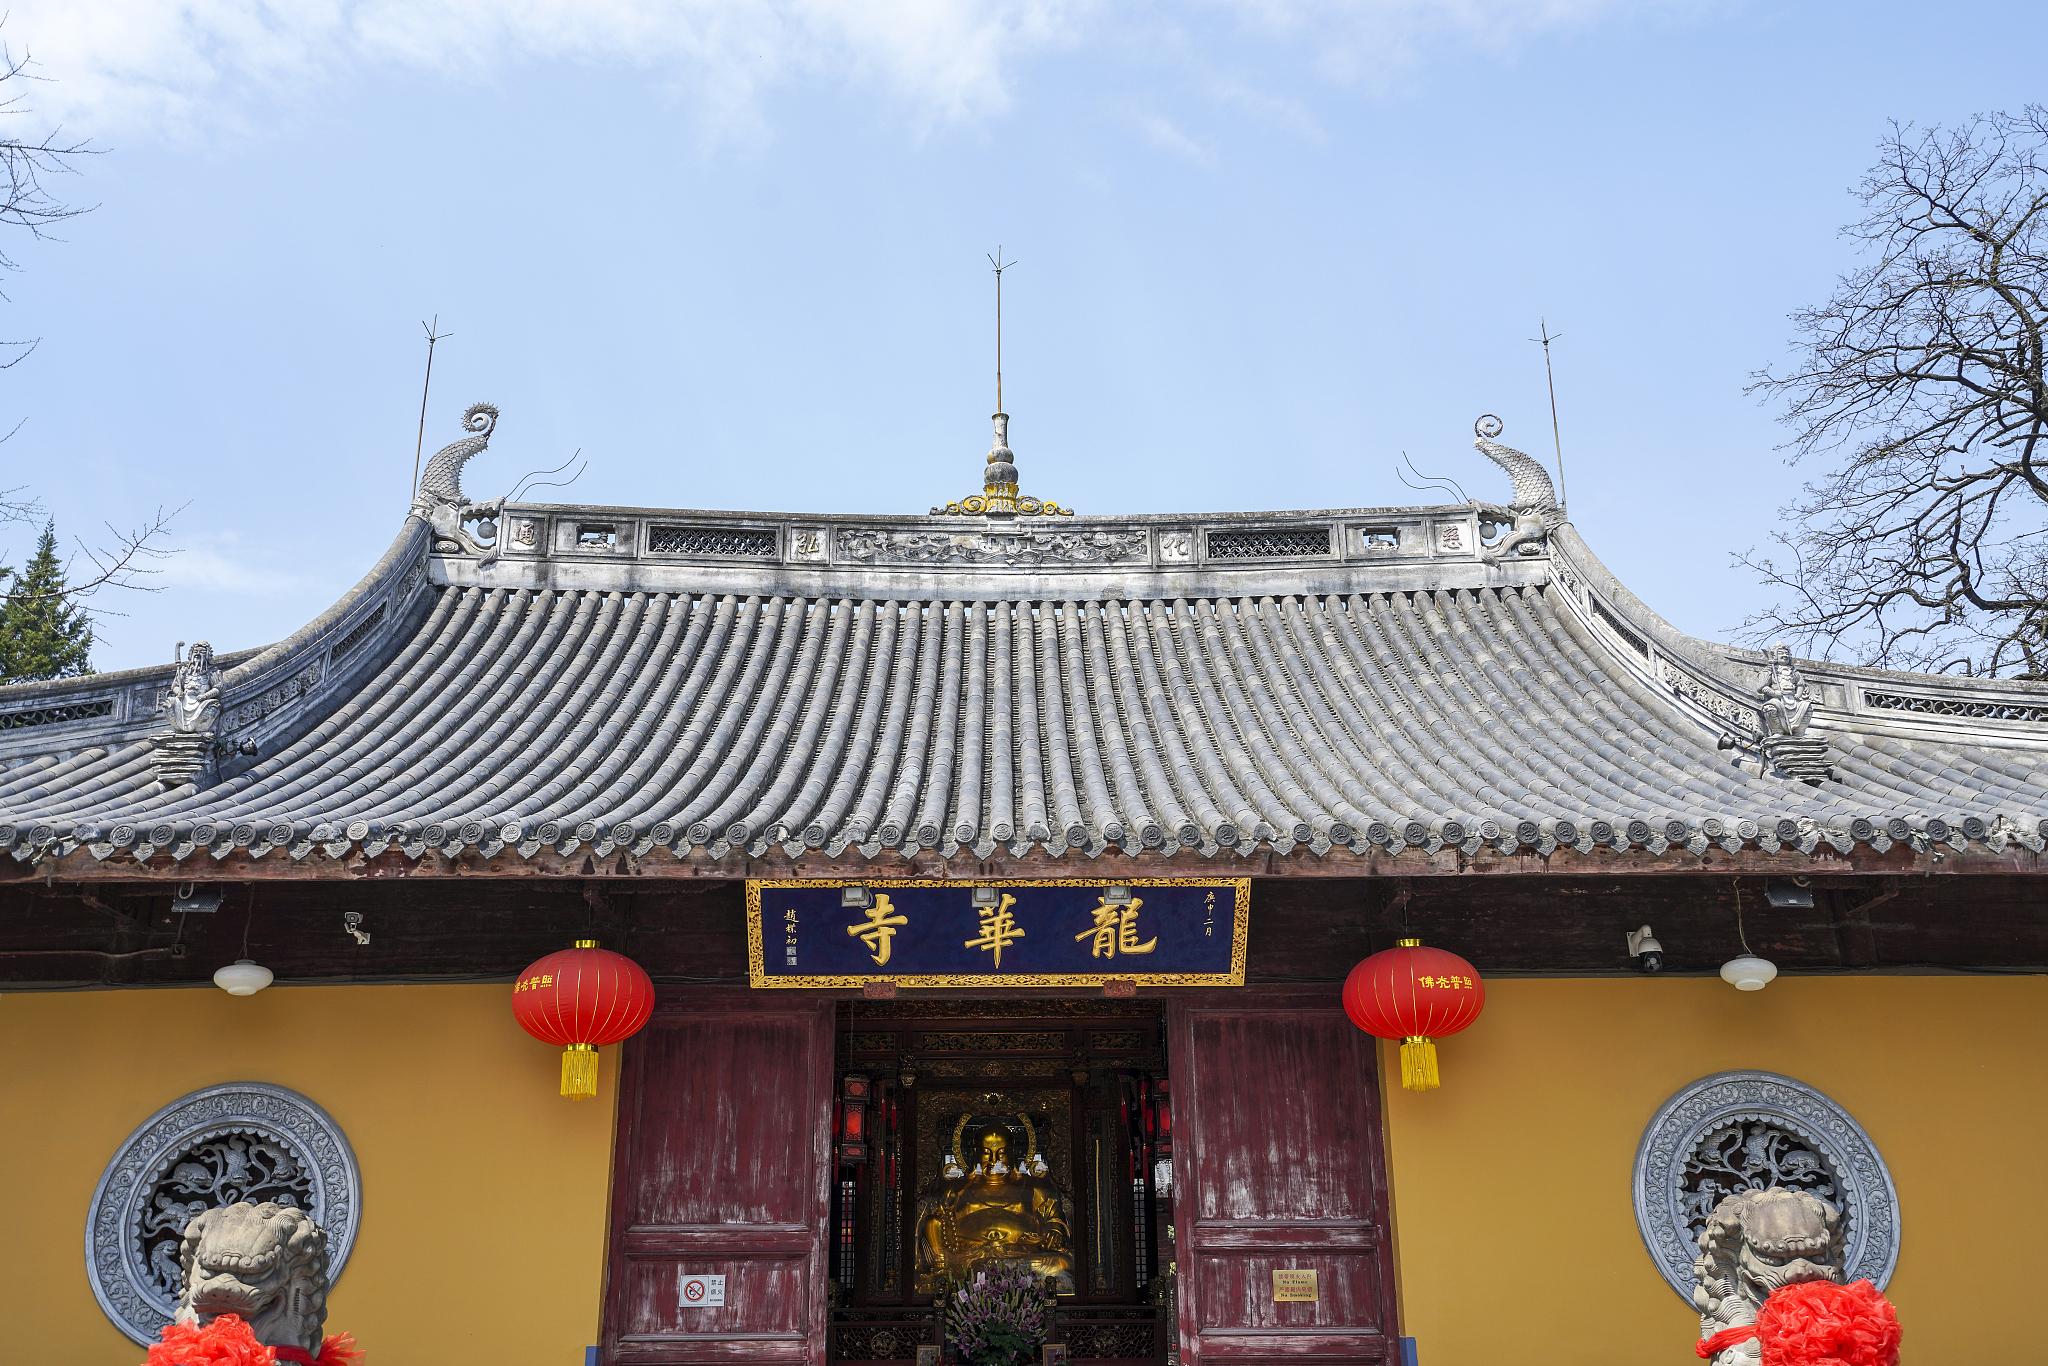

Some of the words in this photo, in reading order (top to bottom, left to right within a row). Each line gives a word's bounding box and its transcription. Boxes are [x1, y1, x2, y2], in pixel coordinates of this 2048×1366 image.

[515, 522, 536, 546] 通
[797, 533, 819, 554] 弘
[1164, 537, 1189, 557] 化
[847, 893, 1158, 969] 龍華寺
[1417, 974, 1473, 990] 佛光普照
